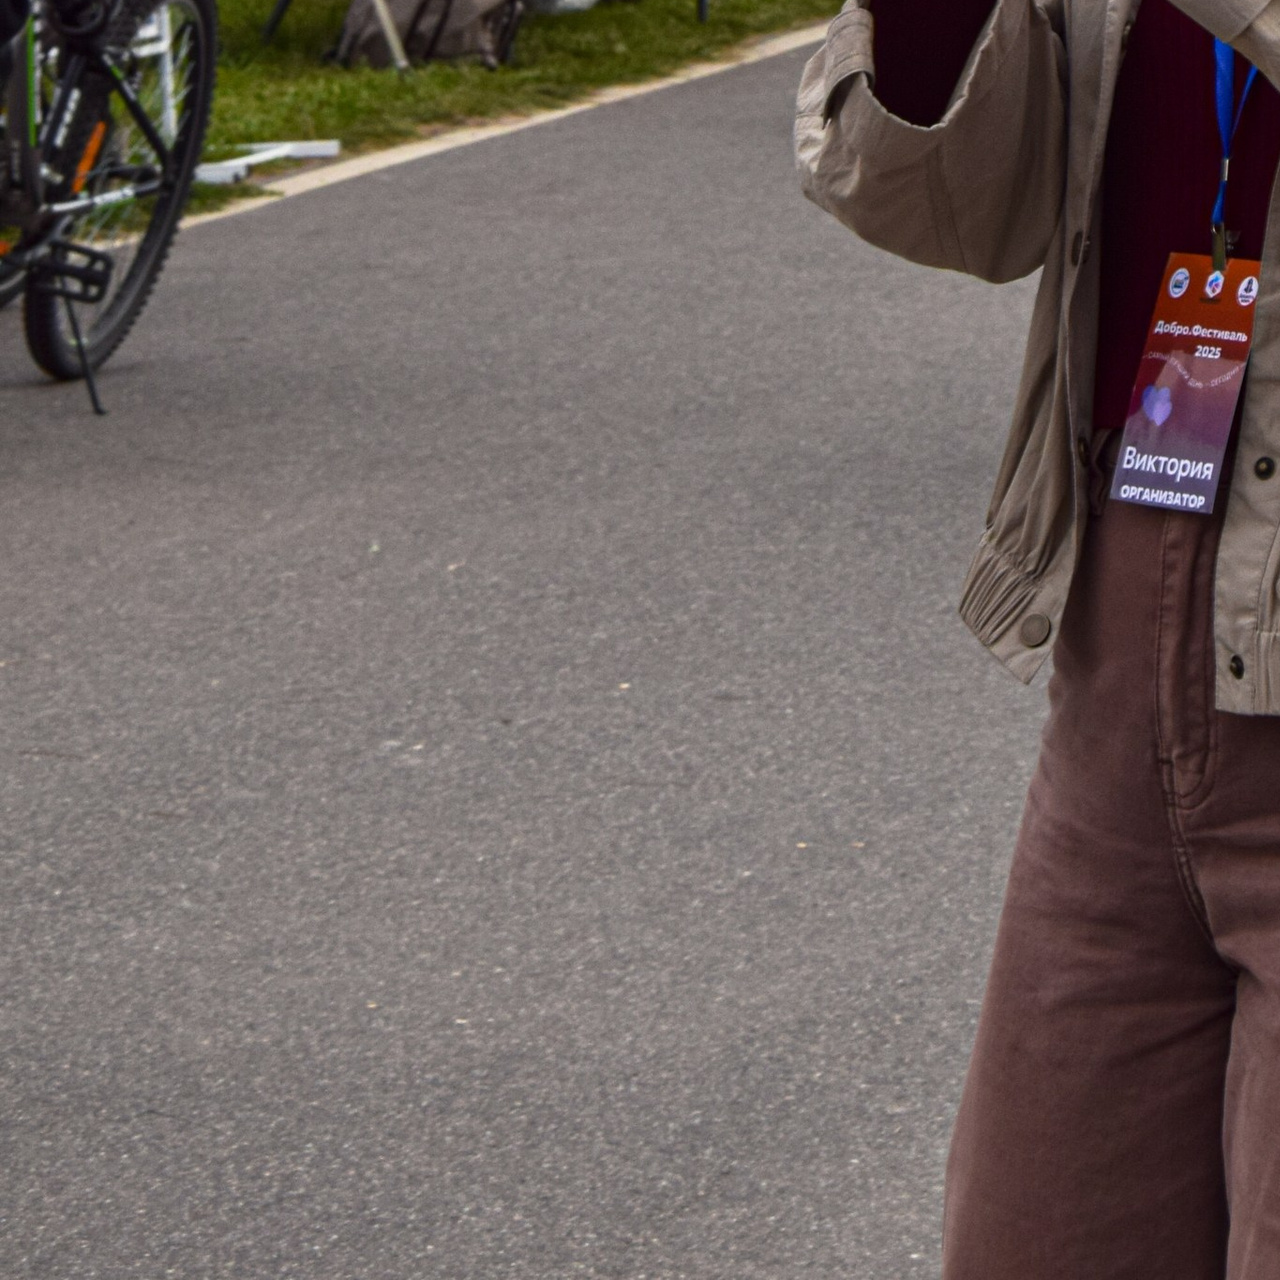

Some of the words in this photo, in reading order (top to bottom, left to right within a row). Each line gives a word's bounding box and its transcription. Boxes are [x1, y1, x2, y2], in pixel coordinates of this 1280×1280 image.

[1154, 320, 1248, 342] Добро.Фестиваль
[1194, 345, 1221, 359] 2025
[1122, 445, 1214, 483] Виктория
[1120, 484, 1206, 509] ОРГАНИЗАТОР
